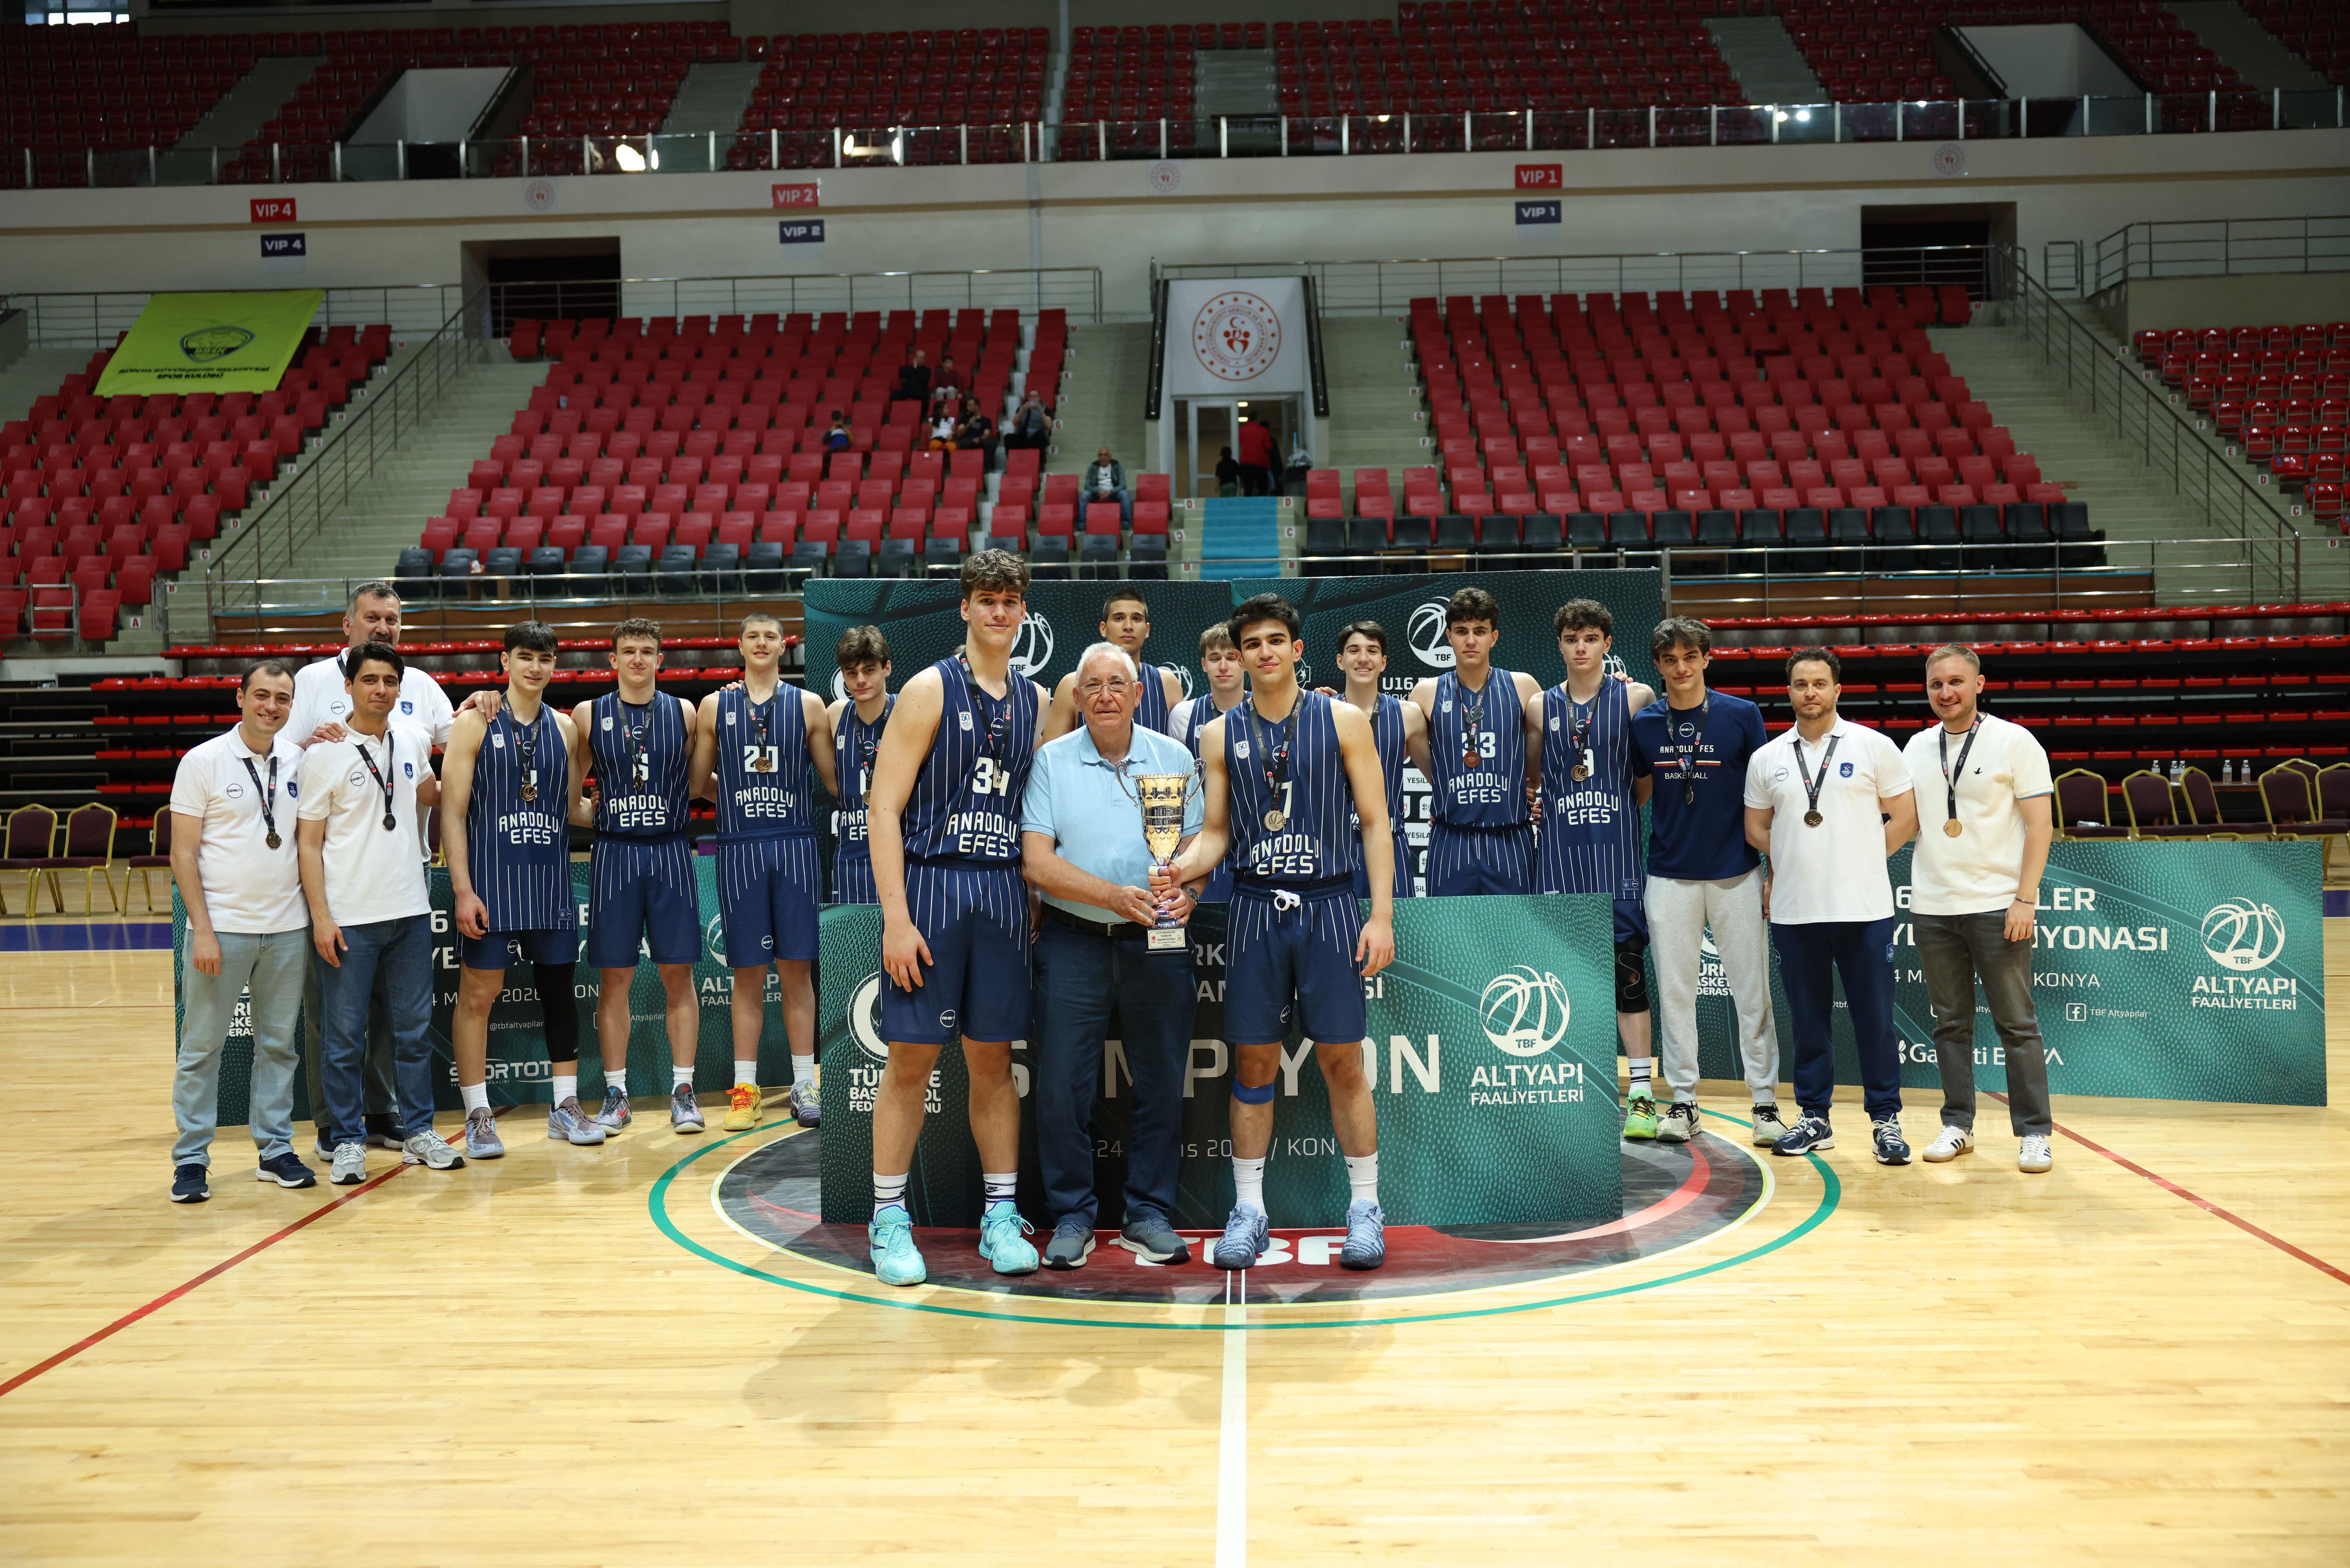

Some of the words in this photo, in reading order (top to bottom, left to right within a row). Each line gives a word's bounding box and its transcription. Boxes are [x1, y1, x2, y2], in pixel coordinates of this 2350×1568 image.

[1520, 169, 1544, 184] VIP
[1548, 169, 1558, 183] 1
[777, 189, 800, 203] VIP
[804, 188, 813, 202] 2
[256, 203, 279, 217] VIP
[282, 202, 291, 216] 4
[1521, 206, 1545, 218] VIP
[1550, 206, 1555, 217] 1
[783, 226, 807, 237] VIP
[264, 240, 288, 251] VIP
[292, 239, 302, 249] 4
[2228, 448, 2233, 456] E
[2261, 476, 2266, 484] D
[1186, 500, 1192, 508] D
[1286, 497, 1291, 506] D
[2293, 506, 2299, 515] C
[233, 520, 238, 528] D
[1287, 528, 1292, 537] C
[201, 550, 208, 560] C
[1184, 562, 1190, 571] B
[133, 619, 139, 627] A
[1382, 677, 1414, 690] U16
[744, 745, 778, 772] 20
[973, 757, 1010, 796] 34
[1449, 773, 1507, 794] ANADOLU
[735, 787, 794, 808] ANADOLU
[1458, 789, 1501, 804] EFES
[1558, 791, 1618, 814] ANADOLU
[745, 803, 786, 818] EFES
[1568, 808, 1611, 825] EFES
[499, 812, 559, 833] ANADOLU
[620, 812, 666, 827] EFES
[947, 811, 1017, 843] ANADOLU
[511, 829, 551, 845] EFES
[959, 834, 1008, 857] EFES
[1251, 834, 1319, 864] ANADOLU
[1256, 855, 1314, 875] EFES
[2034, 972, 2100, 988] KONYA
[2192, 976, 2296, 995] ALTYAPI
[2192, 994, 2296, 1010] FAALİYETLERİ
[2108, 1009, 2149, 1019] Altyapılar
[1515, 1039, 1536, 1049] TBF
[1471, 1063, 1583, 1087] ALTYAPI
[1471, 1088, 1584, 1106] FAALİYETLERİ
